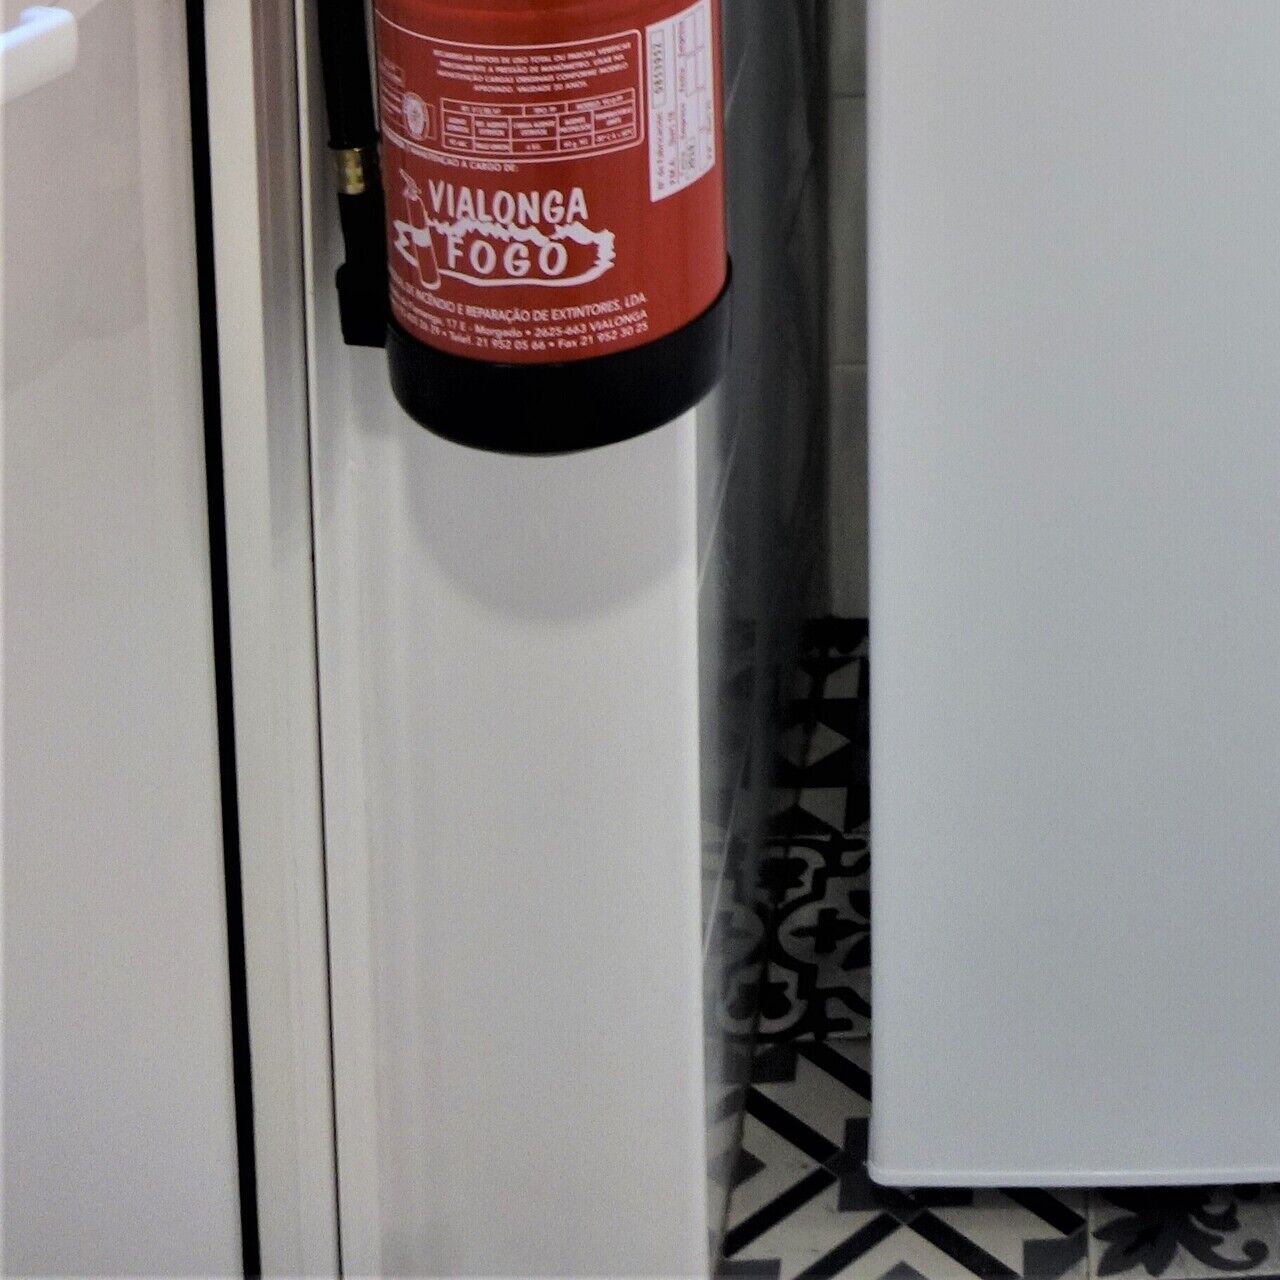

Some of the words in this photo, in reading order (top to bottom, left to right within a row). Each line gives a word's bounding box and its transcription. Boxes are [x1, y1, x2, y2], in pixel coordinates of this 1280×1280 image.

[428, 178, 589, 225] VIALONGA
[446, 235, 568, 277] FOGO
[532, 308, 550, 322] DE
[623, 291, 647, 309] LDA
[589, 309, 648, 332] VIALONGA
